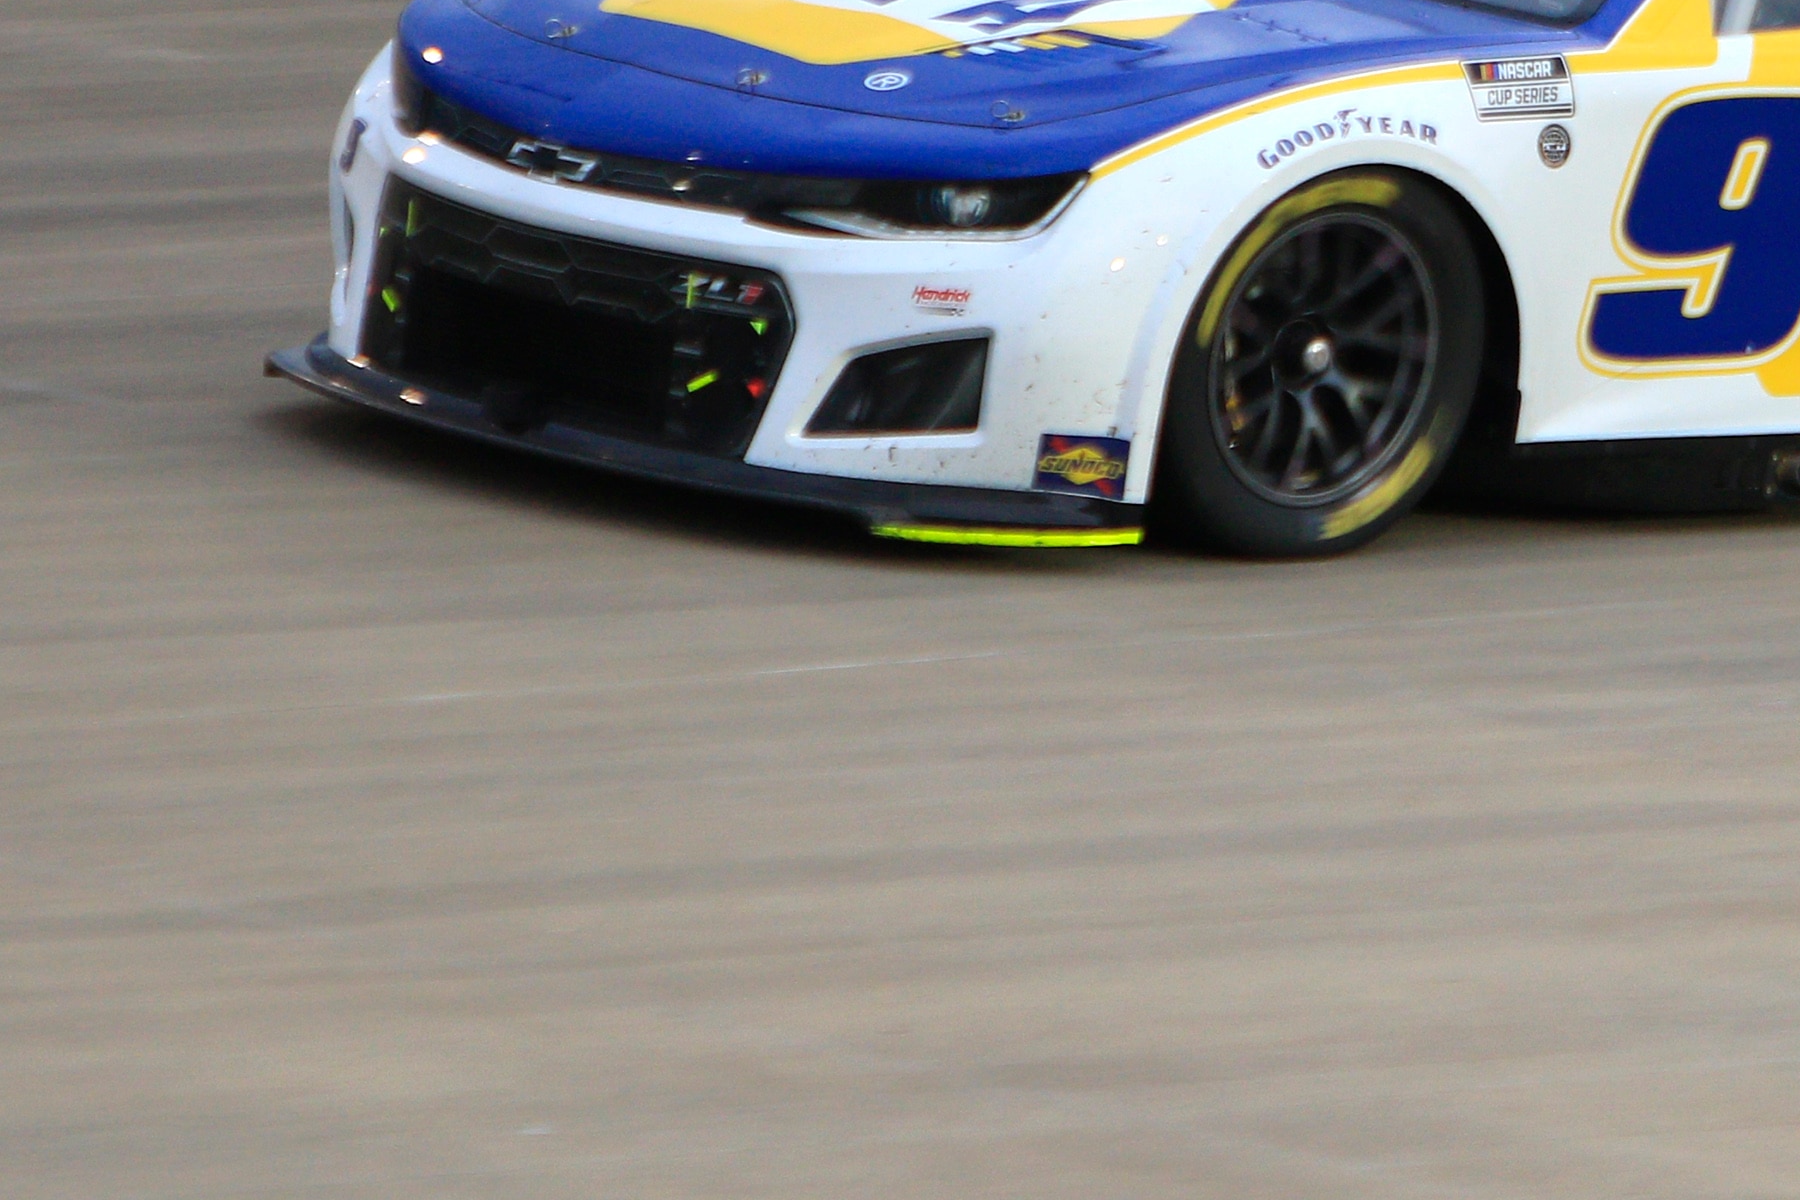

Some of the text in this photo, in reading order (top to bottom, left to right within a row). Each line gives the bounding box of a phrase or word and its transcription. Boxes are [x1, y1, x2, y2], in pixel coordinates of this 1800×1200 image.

[1496, 58, 1553, 81] NASCAR
[1487, 86, 1559, 107] CUP SERIES
[910, 285, 971, 303] Hendrick
[1037, 455, 1125, 480] SUNOCO
